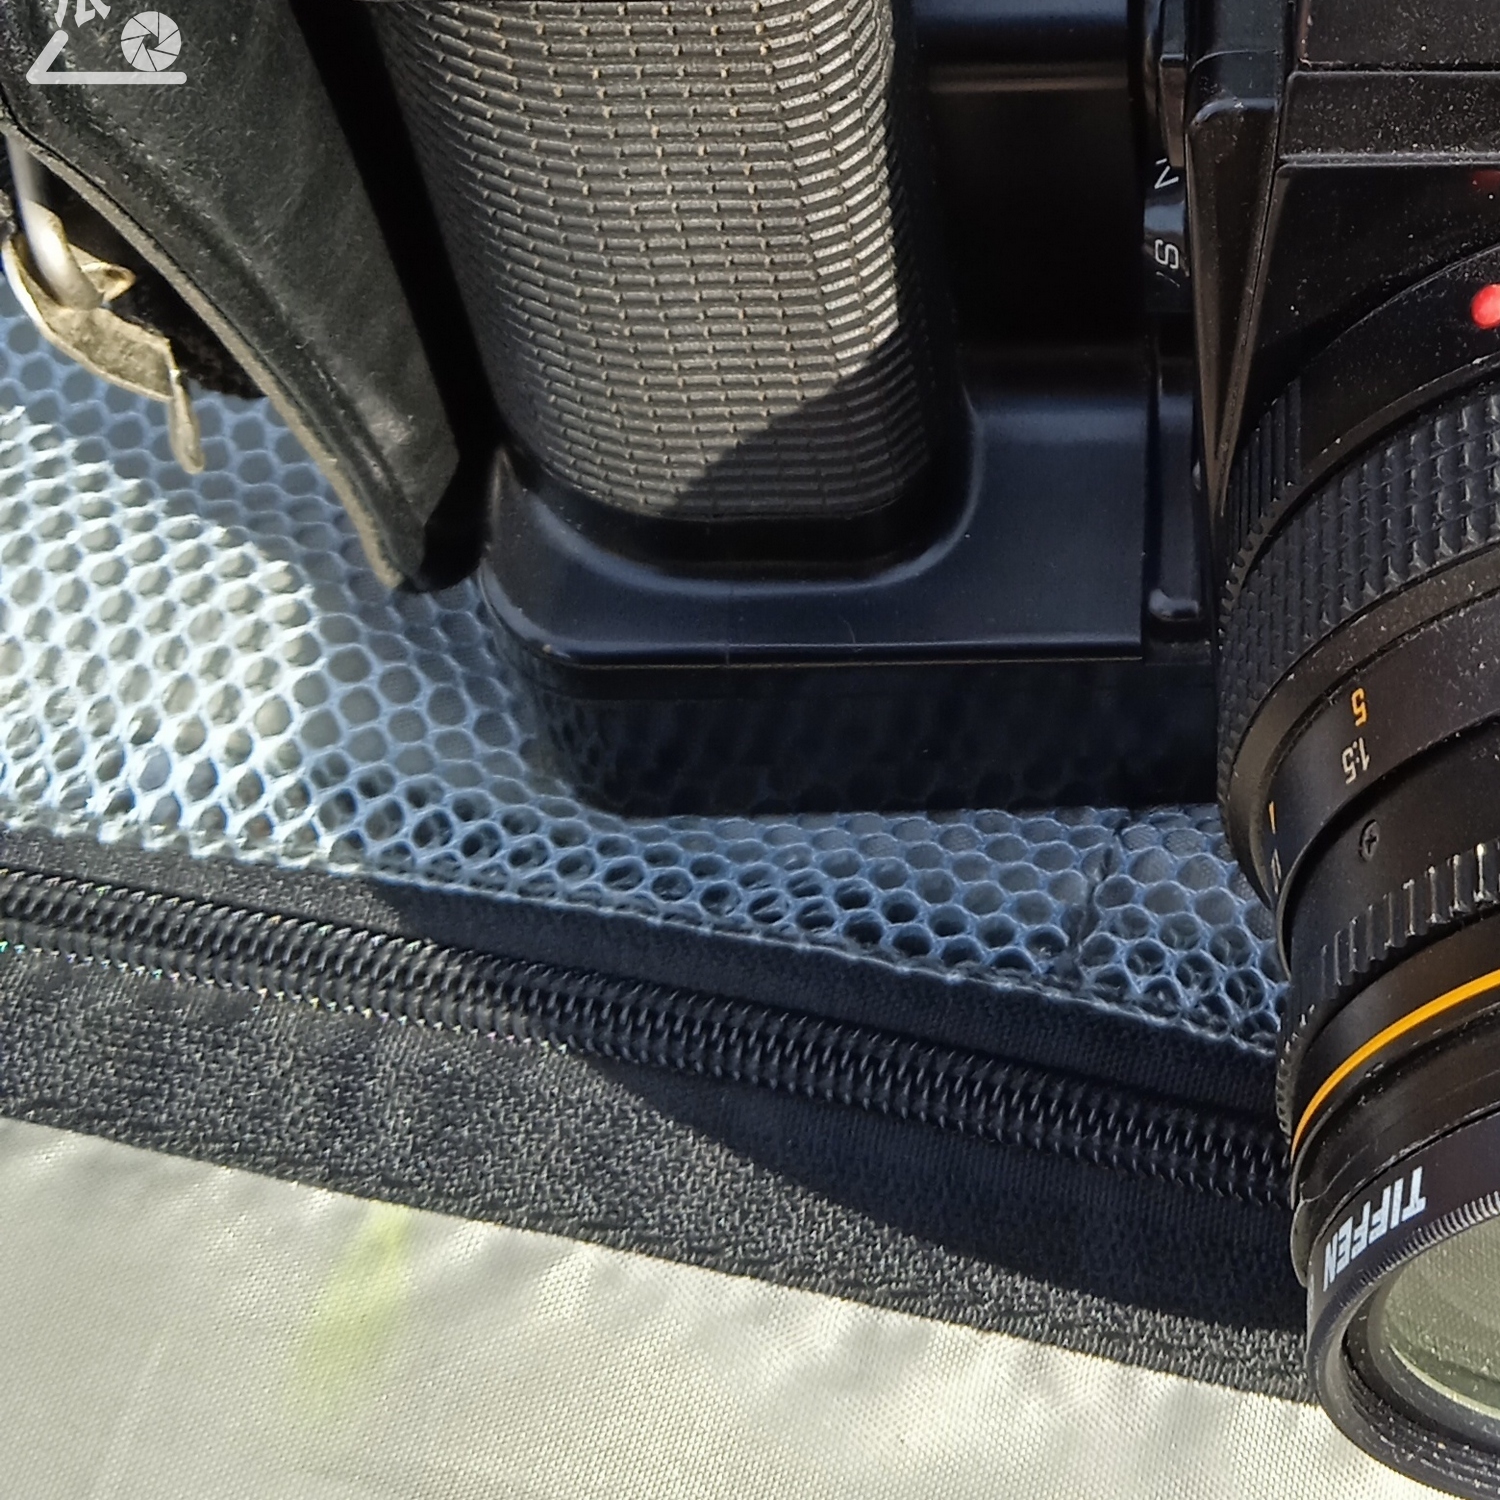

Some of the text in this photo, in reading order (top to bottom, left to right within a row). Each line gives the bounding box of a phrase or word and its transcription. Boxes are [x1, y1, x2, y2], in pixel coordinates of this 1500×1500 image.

[1155, 238, 1180, 270] S
[1351, 687, 1369, 728] 5
[1323, 1165, 1428, 1293] TIFFEN
